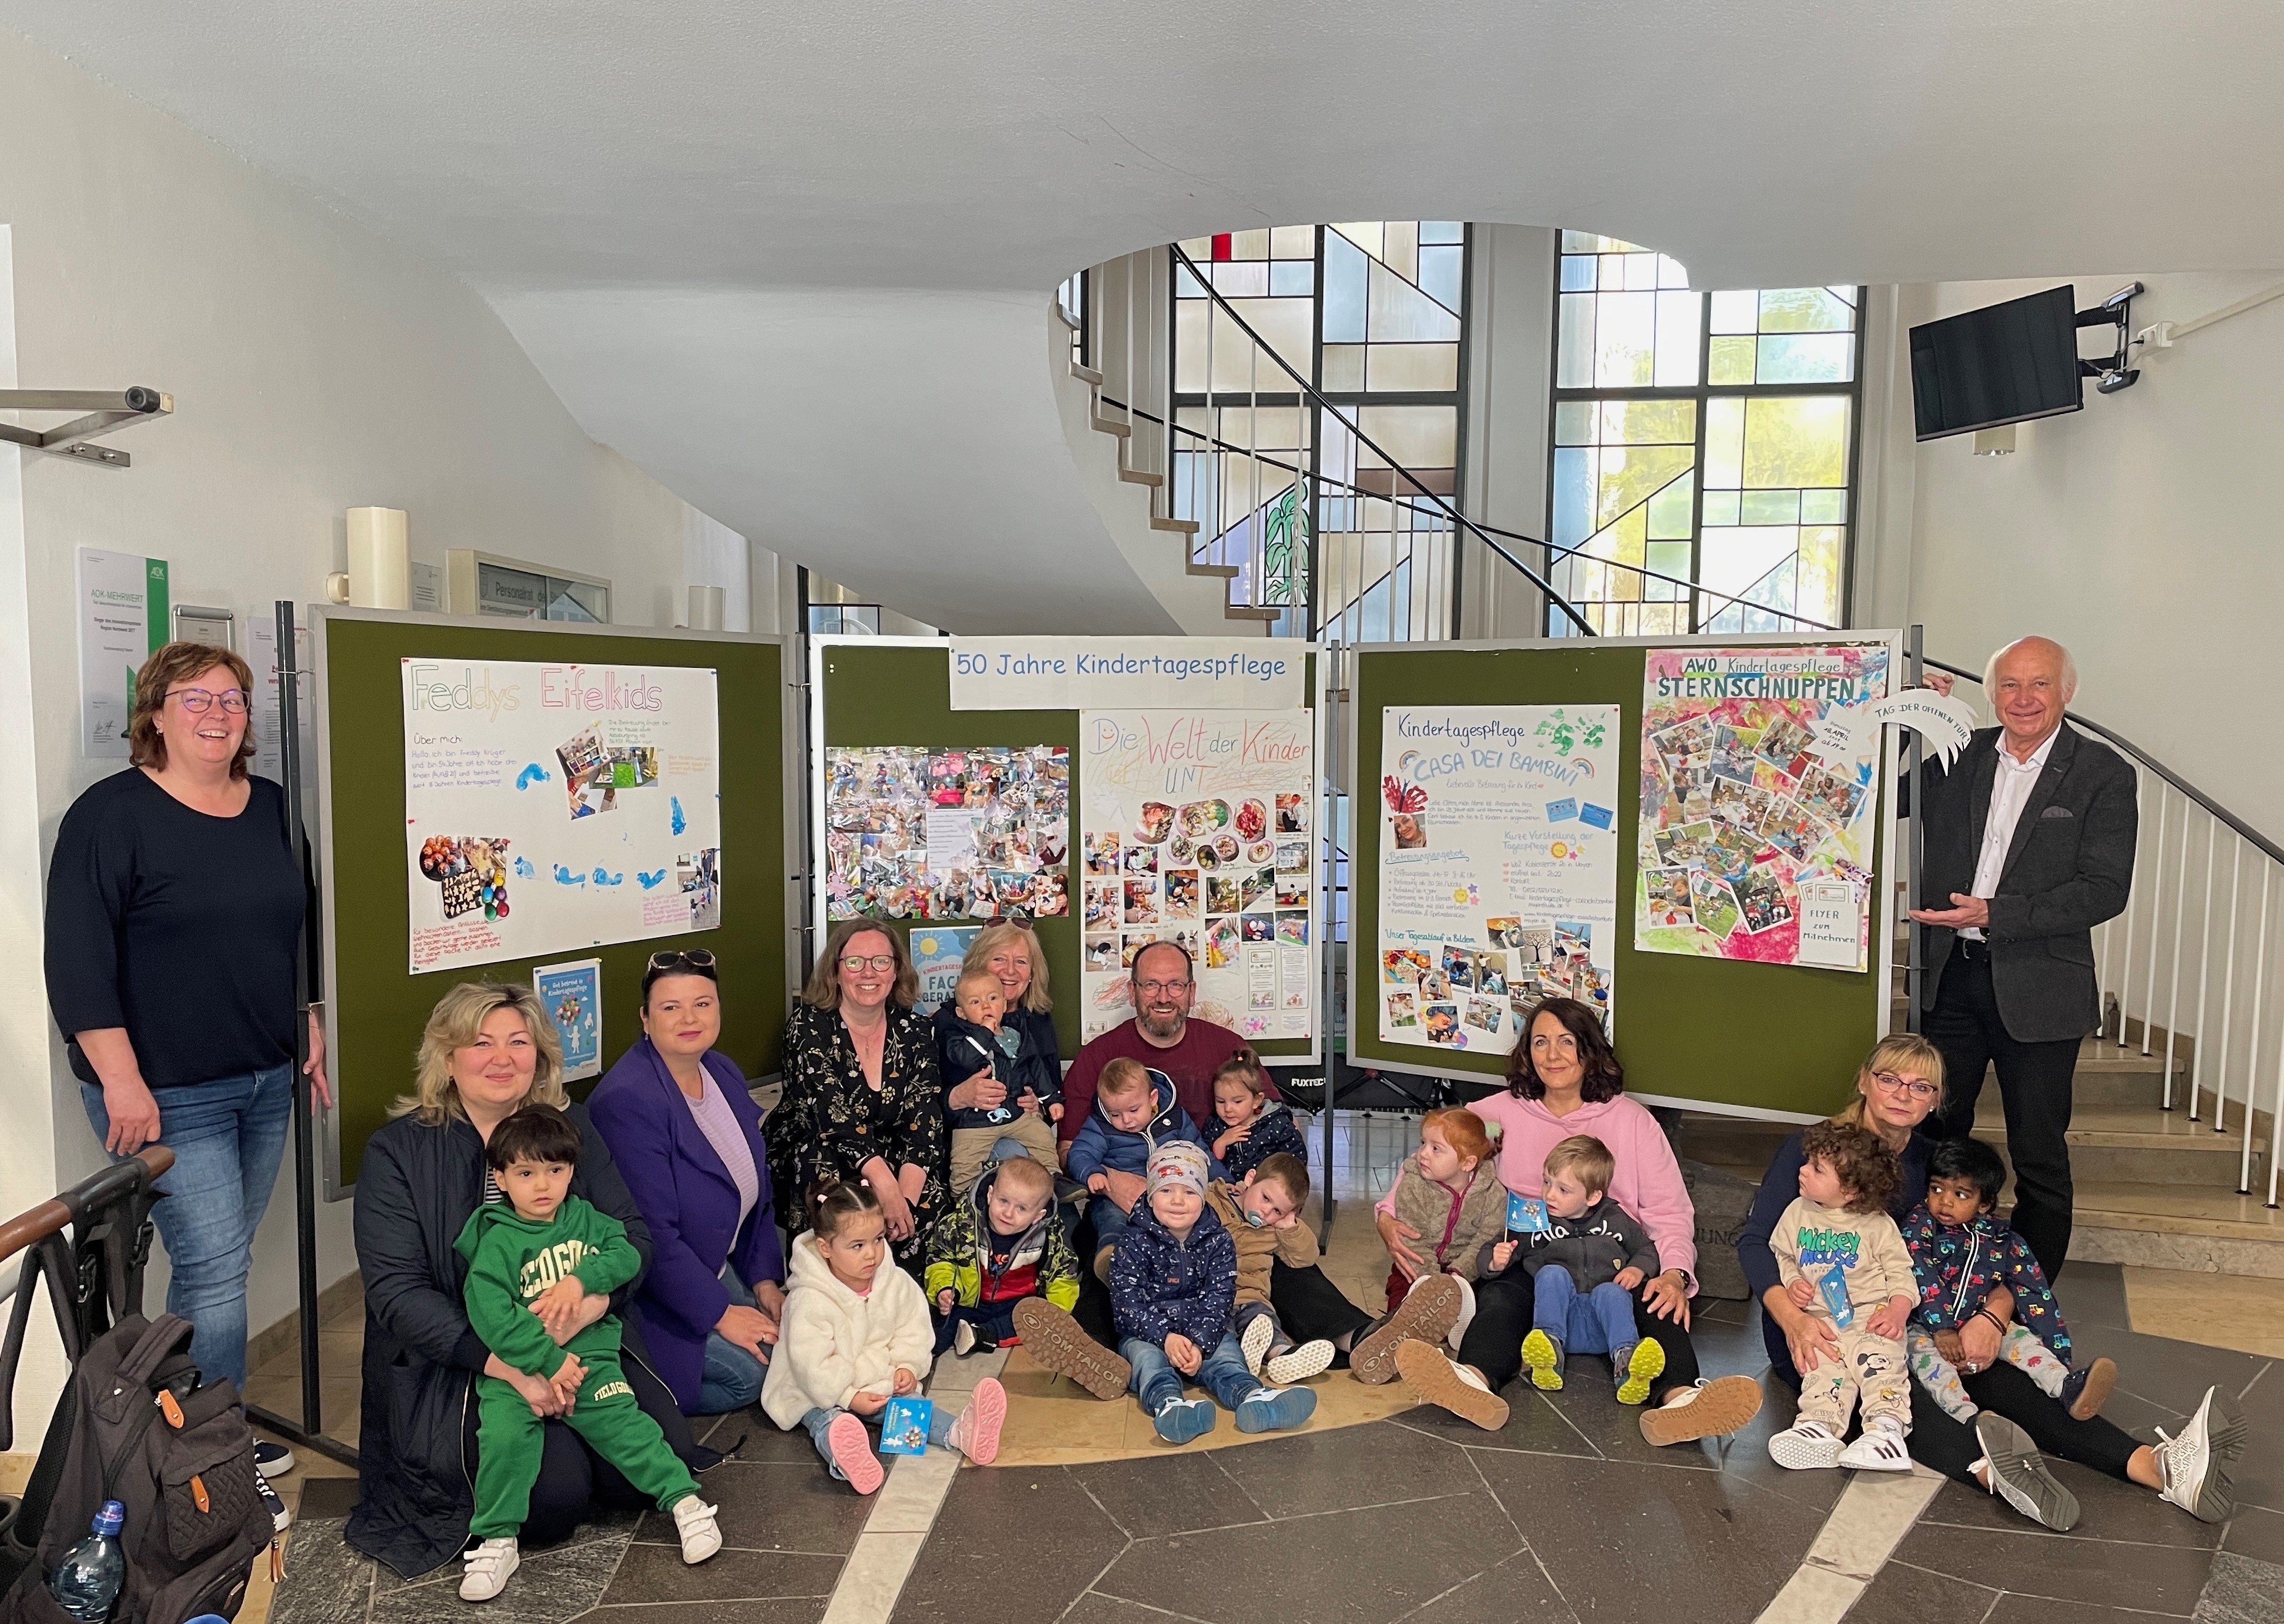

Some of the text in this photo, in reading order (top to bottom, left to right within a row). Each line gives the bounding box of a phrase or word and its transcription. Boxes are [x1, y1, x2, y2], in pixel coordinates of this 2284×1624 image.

[91, 589, 143, 603] AOK-MEHRWERT
[495, 581, 533, 601] Personalrat
[957, 653, 1286, 681] 50 Jahre Kindertagespflege
[1684, 657, 1841, 674] AWO Kindertagespflege
[541, 667, 663, 711] Eifelkids
[1658, 677, 1855, 699] STERNSCHNUPPEN
[1875, 705, 1895, 718] TAG
[1899, 704, 1919, 712] DER
[1922, 705, 1954, 724] OFFENEN
[414, 732, 436, 744] Über
[1399, 713, 1524, 748] Kindertagespflege
[1089, 715, 1310, 765] Die Welt der Kinder
[1413, 749, 1579, 787] CASA DEI BAMBINI
[1504, 830, 1527, 840] Kurze
[1529, 831, 1576, 846] Vorstellung
[1503, 841, 1549, 855] Tagespflege
[1809, 910, 1839, 919] FLYER
[1385, 929, 1405, 939] Unser
[1405, 930, 1445, 945] Tagesablauf
[1453, 934, 1476, 943] Bildern
[923, 964, 963, 975] KINDERTAGESP
[548, 984, 587, 997] Kindertagespflege
[929, 976, 960, 990] FAC
[923, 991, 955, 1002] BERA
[1292, 1078, 1326, 1087] FUXTEC
[1796, 1226, 1861, 1256] Mickey
[1380, 1287, 1455, 1357] TOM TAILOR
[1043, 1326, 1123, 1387] TOM TAILOR
[594, 1381, 634, 1401] FIELDGO
